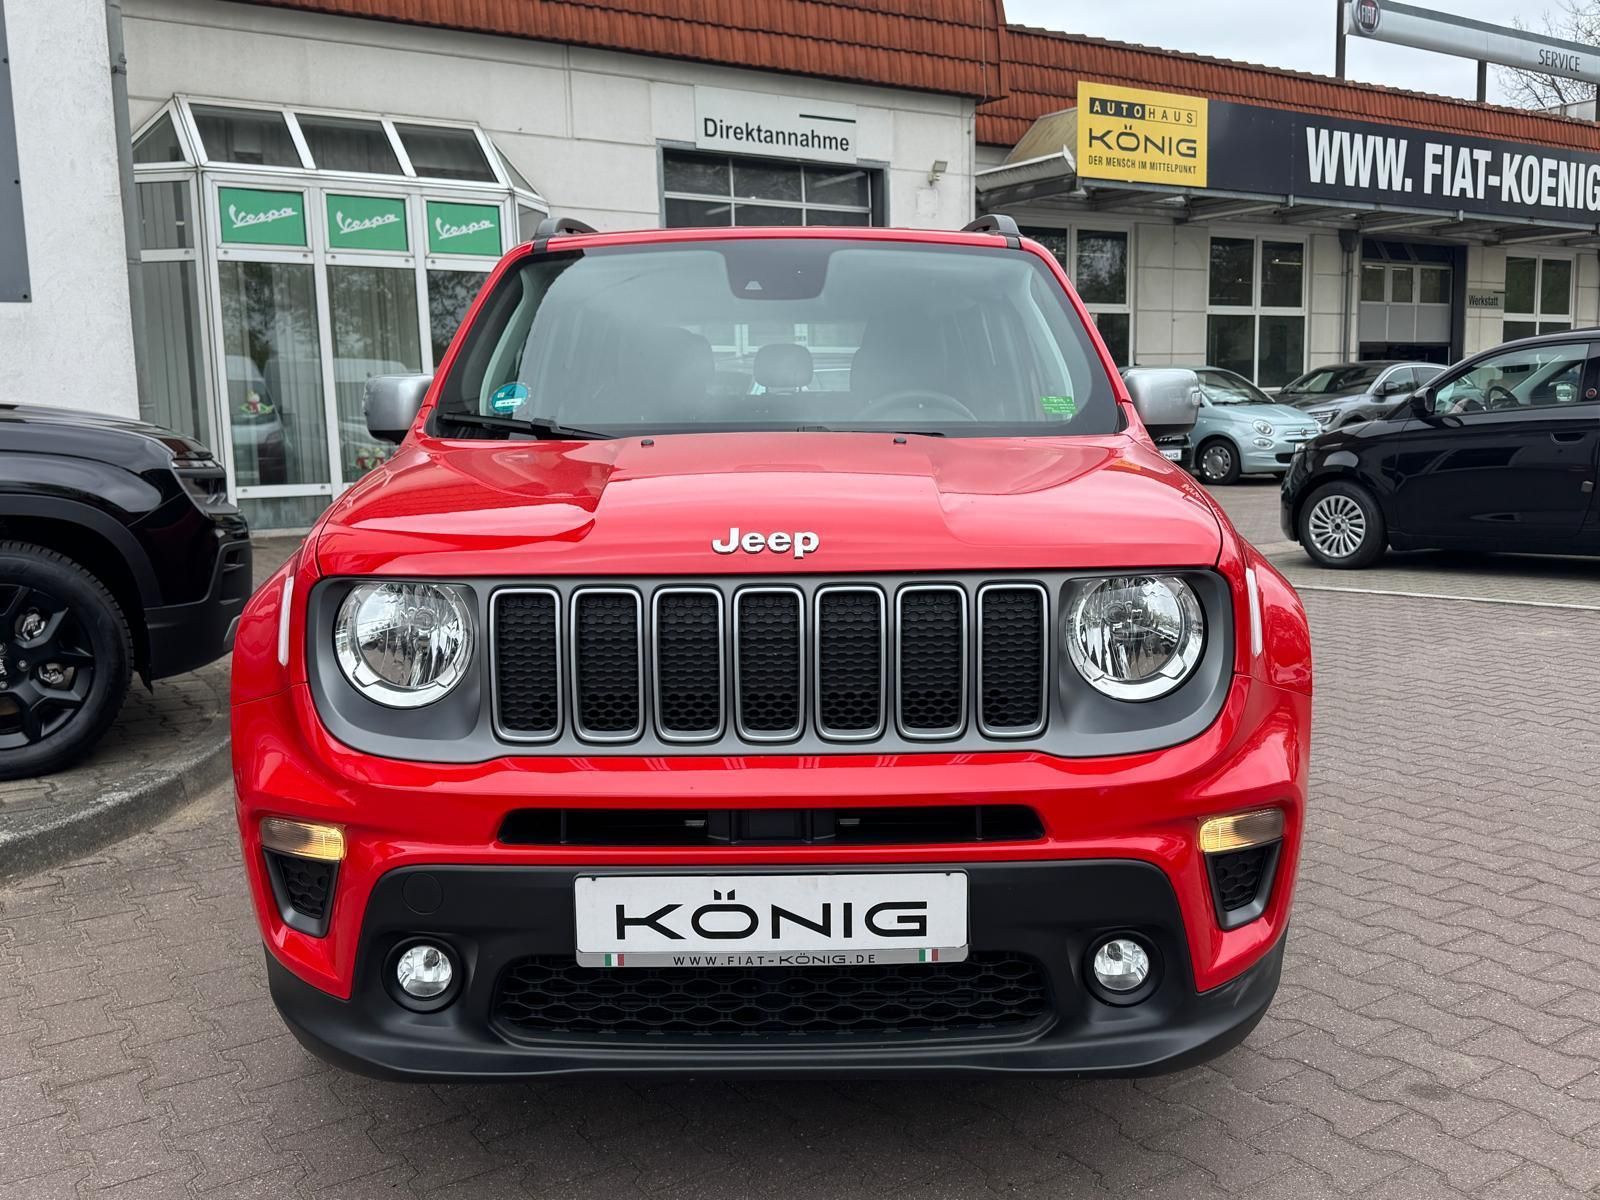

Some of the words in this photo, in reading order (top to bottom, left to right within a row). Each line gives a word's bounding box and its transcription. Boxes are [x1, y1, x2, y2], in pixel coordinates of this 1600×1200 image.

[1361, 4, 1376, 24] FIAT
[1538, 49, 1580, 72] SERVICE
[1093, 100, 1193, 124] AUTOHAUS
[703, 117, 850, 151] Direktannahme
[1088, 123, 1197, 159] KÖNIG
[1088, 155, 1103, 166] DER
[1105, 156, 1136, 169] MENSCH
[1138, 160, 1147, 170] IM
[1149, 162, 1197, 175] MITTELPUNKT
[228, 203, 298, 228] Vespa
[336, 210, 400, 234] Vespa
[435, 217, 495, 240] Vespa
[1468, 295, 1499, 306] Werkstatt
[711, 527, 820, 560] Jeep
[615, 889, 928, 940] KÖNIG
[673, 953, 876, 966] WWW.FIAT-KÖNIG.DE
